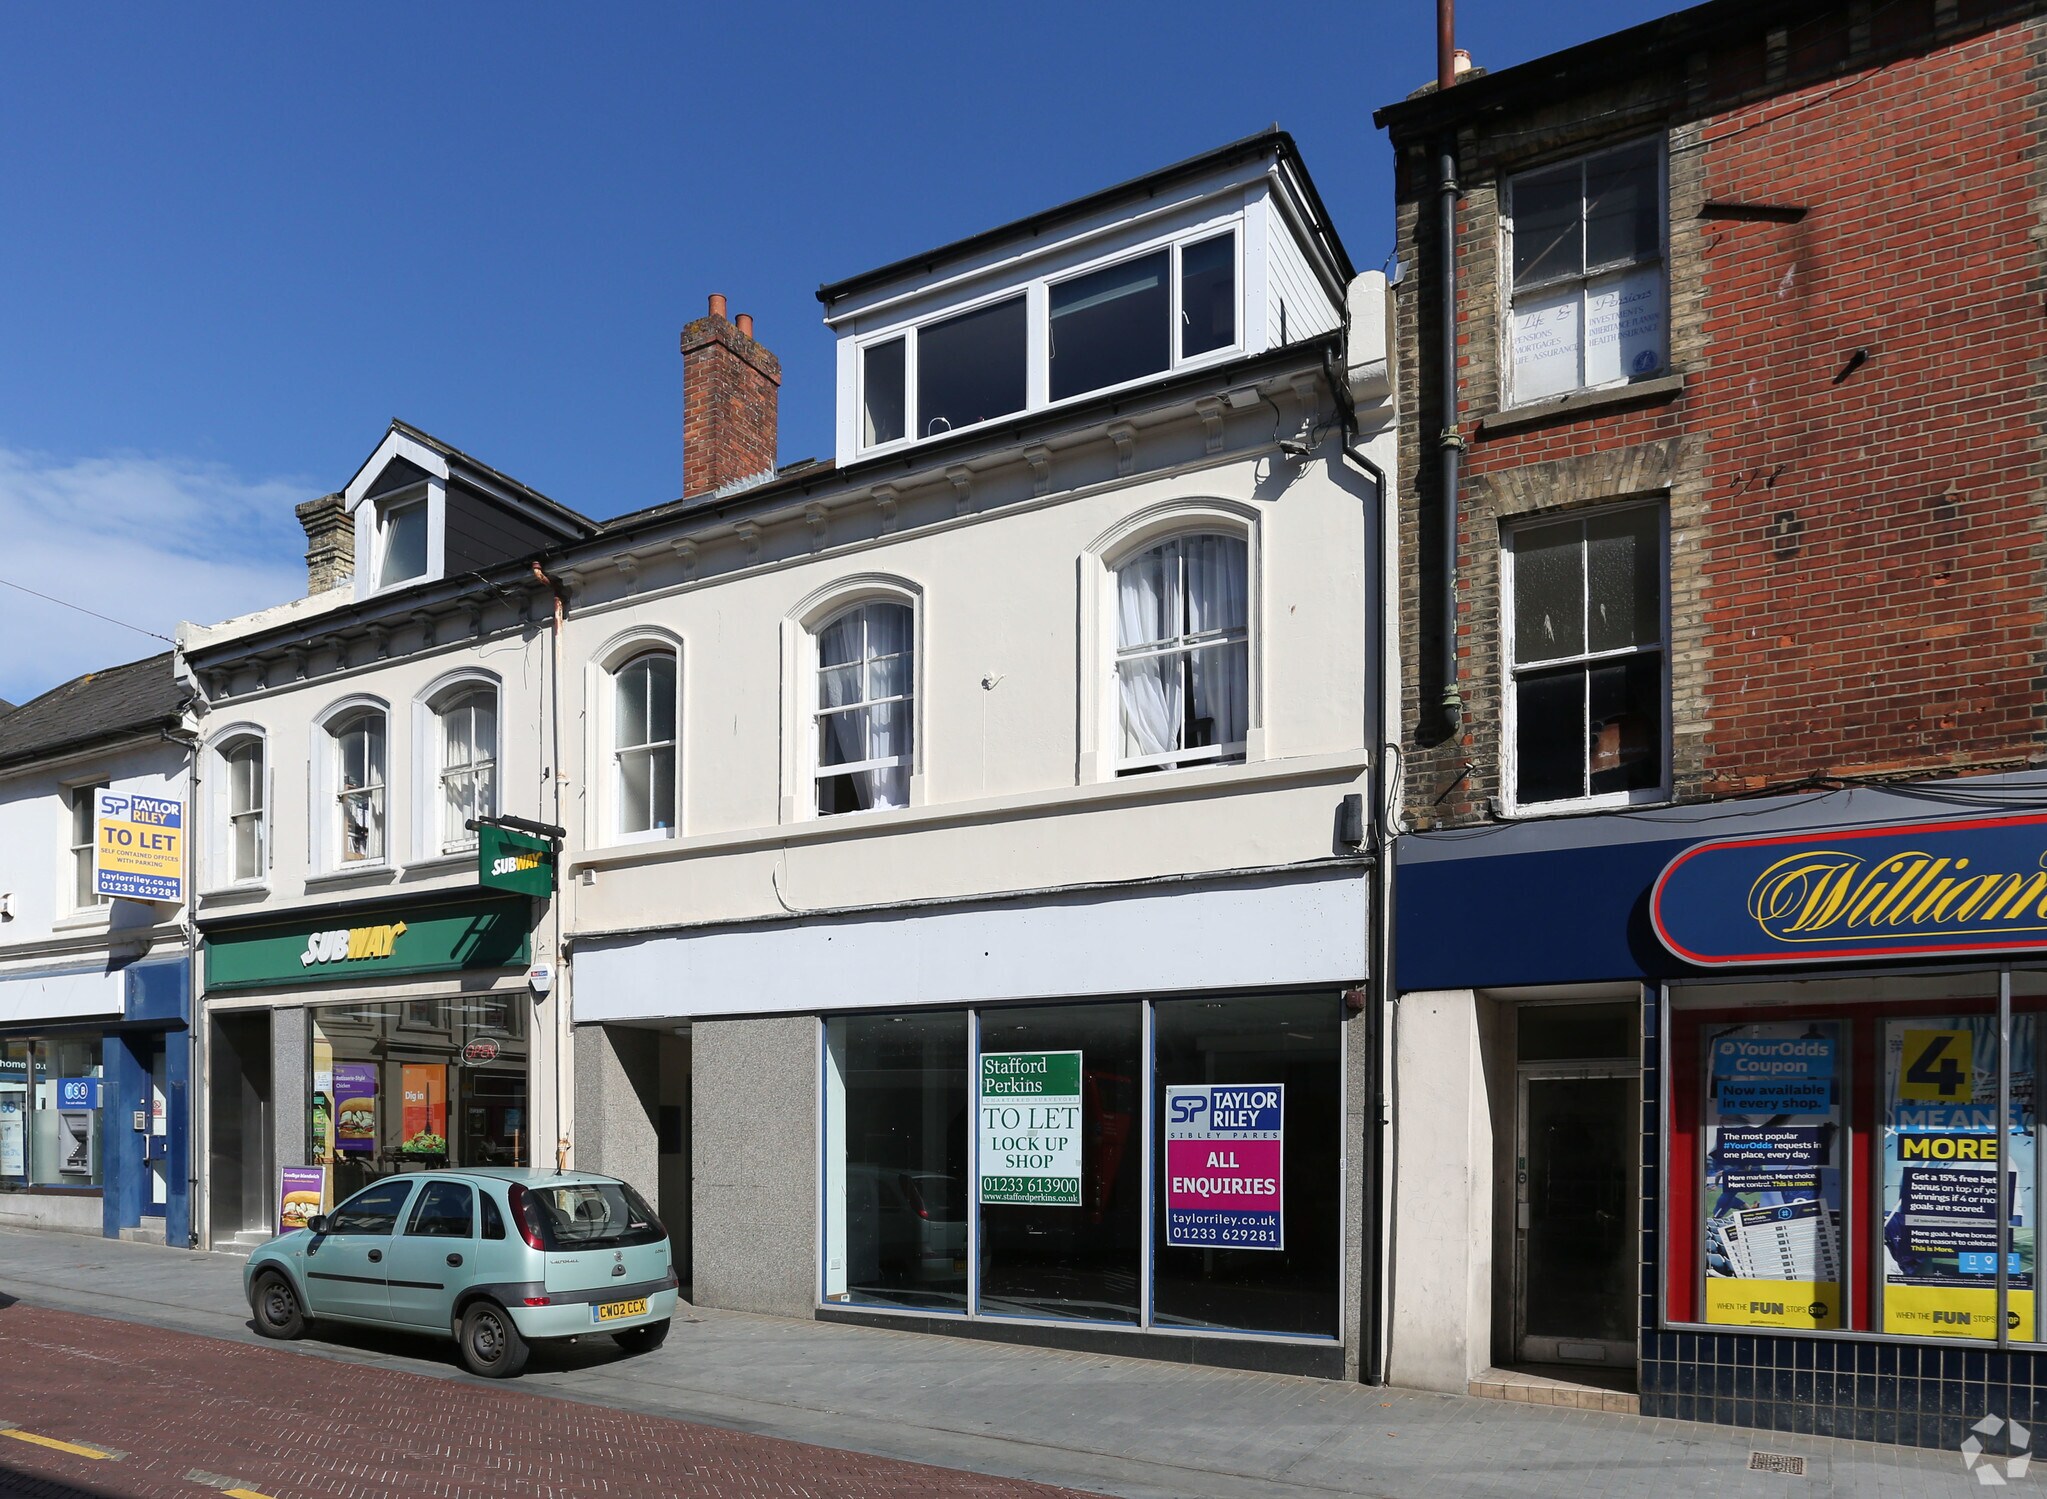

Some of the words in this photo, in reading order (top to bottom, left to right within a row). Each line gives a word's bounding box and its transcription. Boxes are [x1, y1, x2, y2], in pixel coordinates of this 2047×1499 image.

[1521, 312, 1545, 330] Life
[1594, 290, 1652, 312] Pensions
[1589, 307, 1643, 325] INVESTMENTS
[1589, 318, 1632, 336] INHERITANCE
[1514, 329, 1552, 344] PENSIONS
[1589, 334, 1616, 346] HEALTH
[1618, 324, 1657, 341] INSURANCE
[1515, 337, 1561, 354] MORTGAGES
[1515, 356, 1529, 365] LIFE
[1534, 343, 1578, 361] ASSURANCE
[132, 799, 179, 815] TAYLOR
[133, 810, 167, 824] RILEY
[104, 827, 132, 846] TO
[140, 832, 176, 851] LET
[116, 850, 152, 859] CONTAINED
[154, 854, 178, 863] OFFICES
[135, 860, 163, 868] PARKING
[491, 852, 543, 876] SUBWAY
[102, 872, 177, 887] taylorriley.co.uk
[102, 882, 135, 892] 01233
[139, 886, 178, 897] 629281
[300, 921, 407, 967] SUBWAY
[466, 1044, 497, 1059] OPEN
[985, 1057, 1047, 1075] Stafford
[1736, 1059, 1808, 1075] Coupon
[1907, 1036, 1965, 1095] 4
[65, 1084, 87, 1098] TSB
[985, 1078, 1043, 1093] Perkins
[1724, 1086, 1756, 1096] Now
[1760, 1084, 1825, 1095] available
[406, 1091, 416, 1101] Dig
[418, 1091, 424, 1100] in
[1171, 1096, 1208, 1122] SP
[1213, 1092, 1277, 1109] TAYLOR
[1724, 1099, 1736, 1108] in
[1739, 1100, 1779, 1110] every
[1782, 1098, 1821, 1110] shop.
[983, 1107, 1020, 1130] TO
[1028, 1107, 1079, 1129] LET
[1214, 1110, 1261, 1127] RILEY
[992, 1137, 1040, 1151] LOCK
[1046, 1137, 1068, 1151] UP
[1765, 1133, 1798, 1141] popular
[1774, 1142, 1812, 1150] requests
[1904, 1138, 1998, 1160] MORE
[1006, 1154, 1054, 1169] SHOP
[1206, 1152, 1240, 1168] ALL
[1741, 1152, 1765, 1160] place,
[1767, 1152, 1791, 1160] every
[1792, 1151, 1811, 1159] day.
[984, 1178, 1023, 1192] 01233
[1028, 1178, 1078, 1193] 613900
[1912, 1173, 1929, 1181] Get
[1981, 1176, 1997, 1184] bet
[1173, 1178, 1276, 1198] ENQUIRIES
[1911, 1183, 1940, 1191] bonus
[1956, 1186, 1972, 1194] top
[1973, 1186, 1985, 1194] of
[1985, 1188, 1997, 1196] yo
[984, 1193, 1078, 1203] www.staffordperkins.co.uk
[1911, 1194, 1950, 1202] winnings
[1910, 1203, 1934, 1211] goals
[1952, 1205, 1986, 1213] scored.
[1173, 1213, 1276, 1226] taylorriley.co.uk
[1174, 1228, 1217, 1239] 01233
[1222, 1229, 1276, 1242] 629281
[600, 1303, 626, 1318] CW02
[628, 1301, 646, 1314] CCX
[1750, 1302, 1784, 1315] FUN
[1786, 1306, 1806, 1314] STOPS
[1918, 1312, 1931, 1320] THE
[1933, 1311, 1971, 1325] FUN
[1974, 1315, 1996, 1323] STOPS
